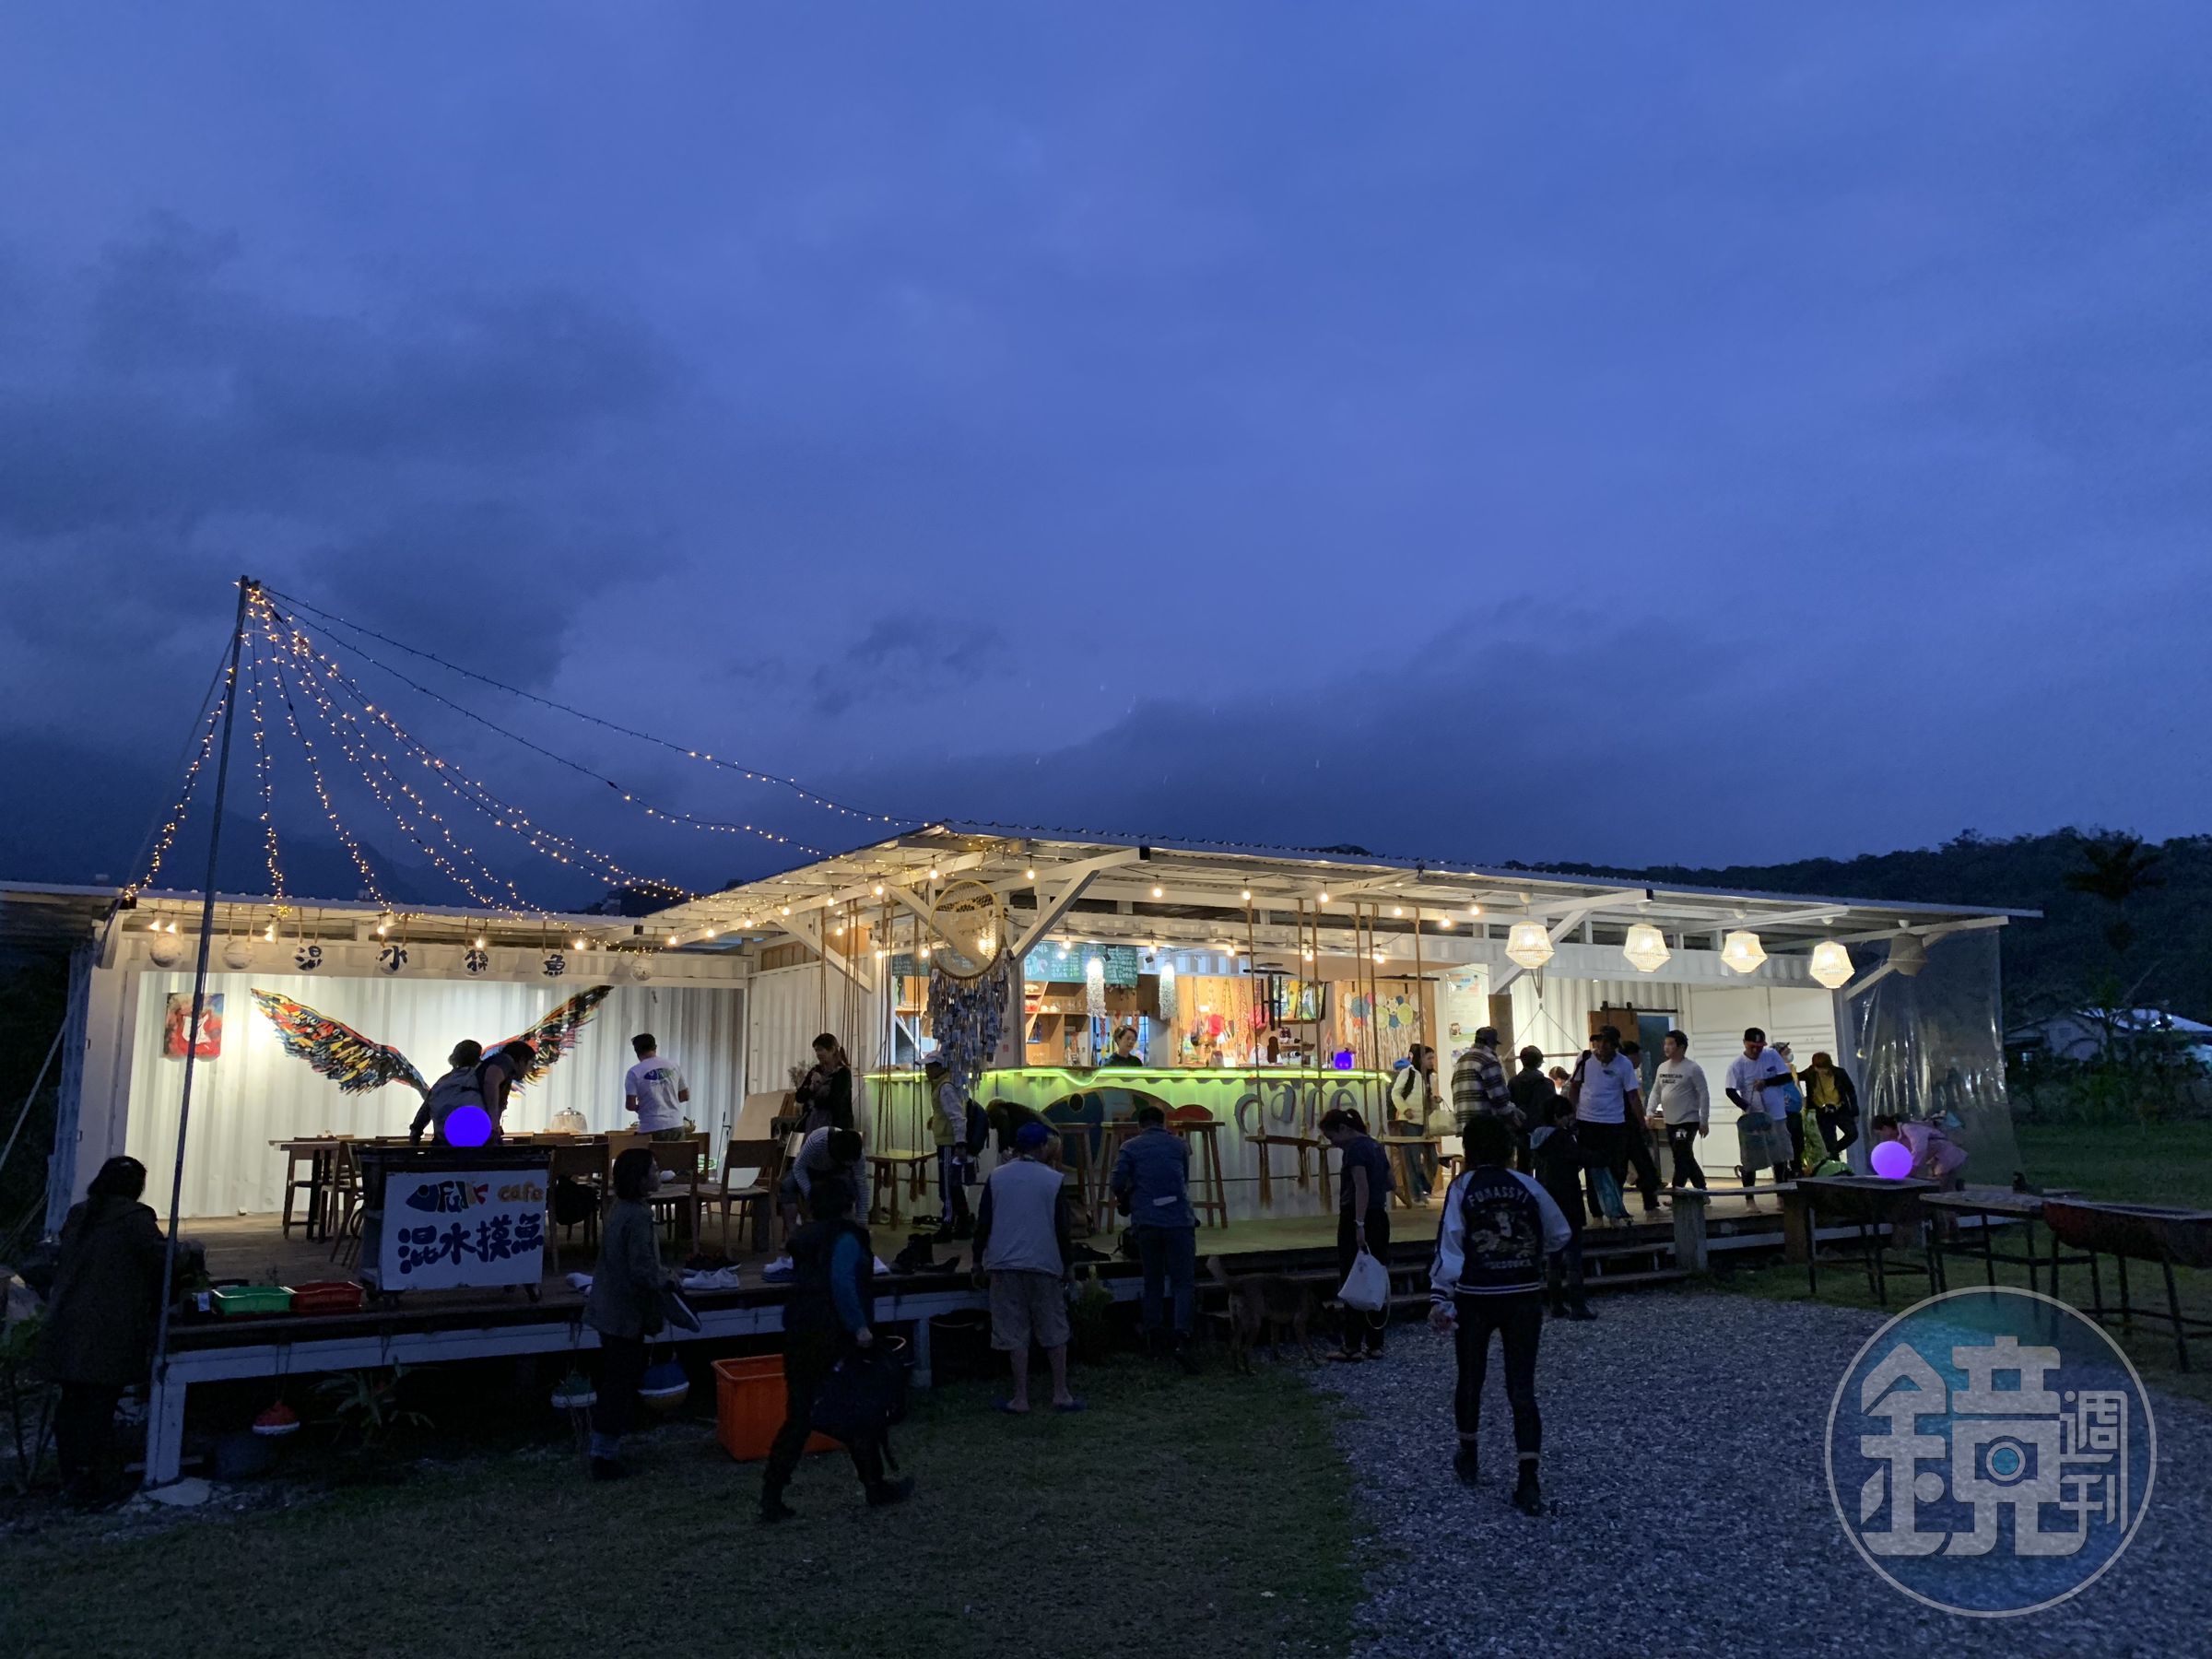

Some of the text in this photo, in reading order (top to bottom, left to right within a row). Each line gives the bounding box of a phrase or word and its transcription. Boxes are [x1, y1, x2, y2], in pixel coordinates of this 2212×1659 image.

[375, 945, 407, 969] 水
[498, 1181, 544, 1203] cafe
[397, 1213, 545, 1275] 混水摸魚
